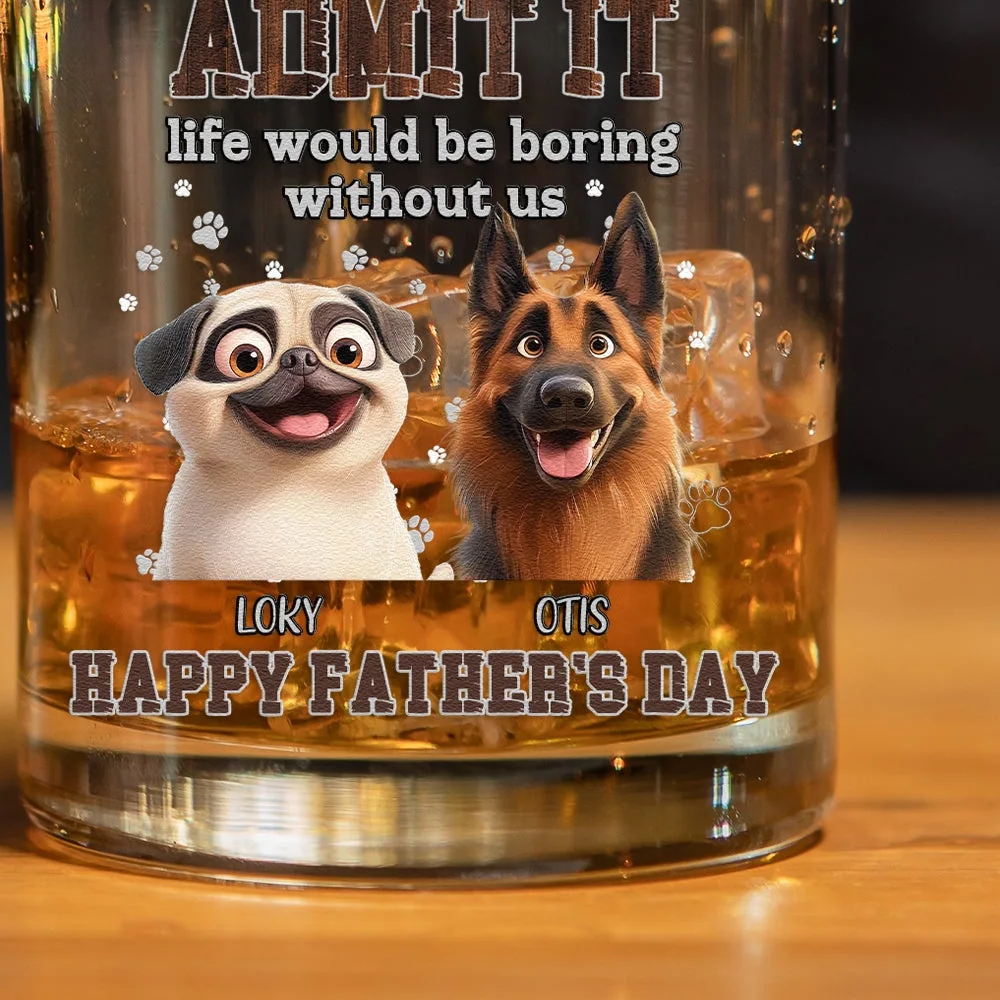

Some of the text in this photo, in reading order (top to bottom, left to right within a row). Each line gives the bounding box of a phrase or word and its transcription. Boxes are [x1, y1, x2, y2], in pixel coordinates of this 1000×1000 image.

[166, 117, 682, 176] life would be boring
[284, 173, 566, 219] without us
[234, 595, 325, 635] LOKY
[534, 595, 611, 635] OTIS
[68, 649, 780, 718] HAPPY FATHER'S DAY
